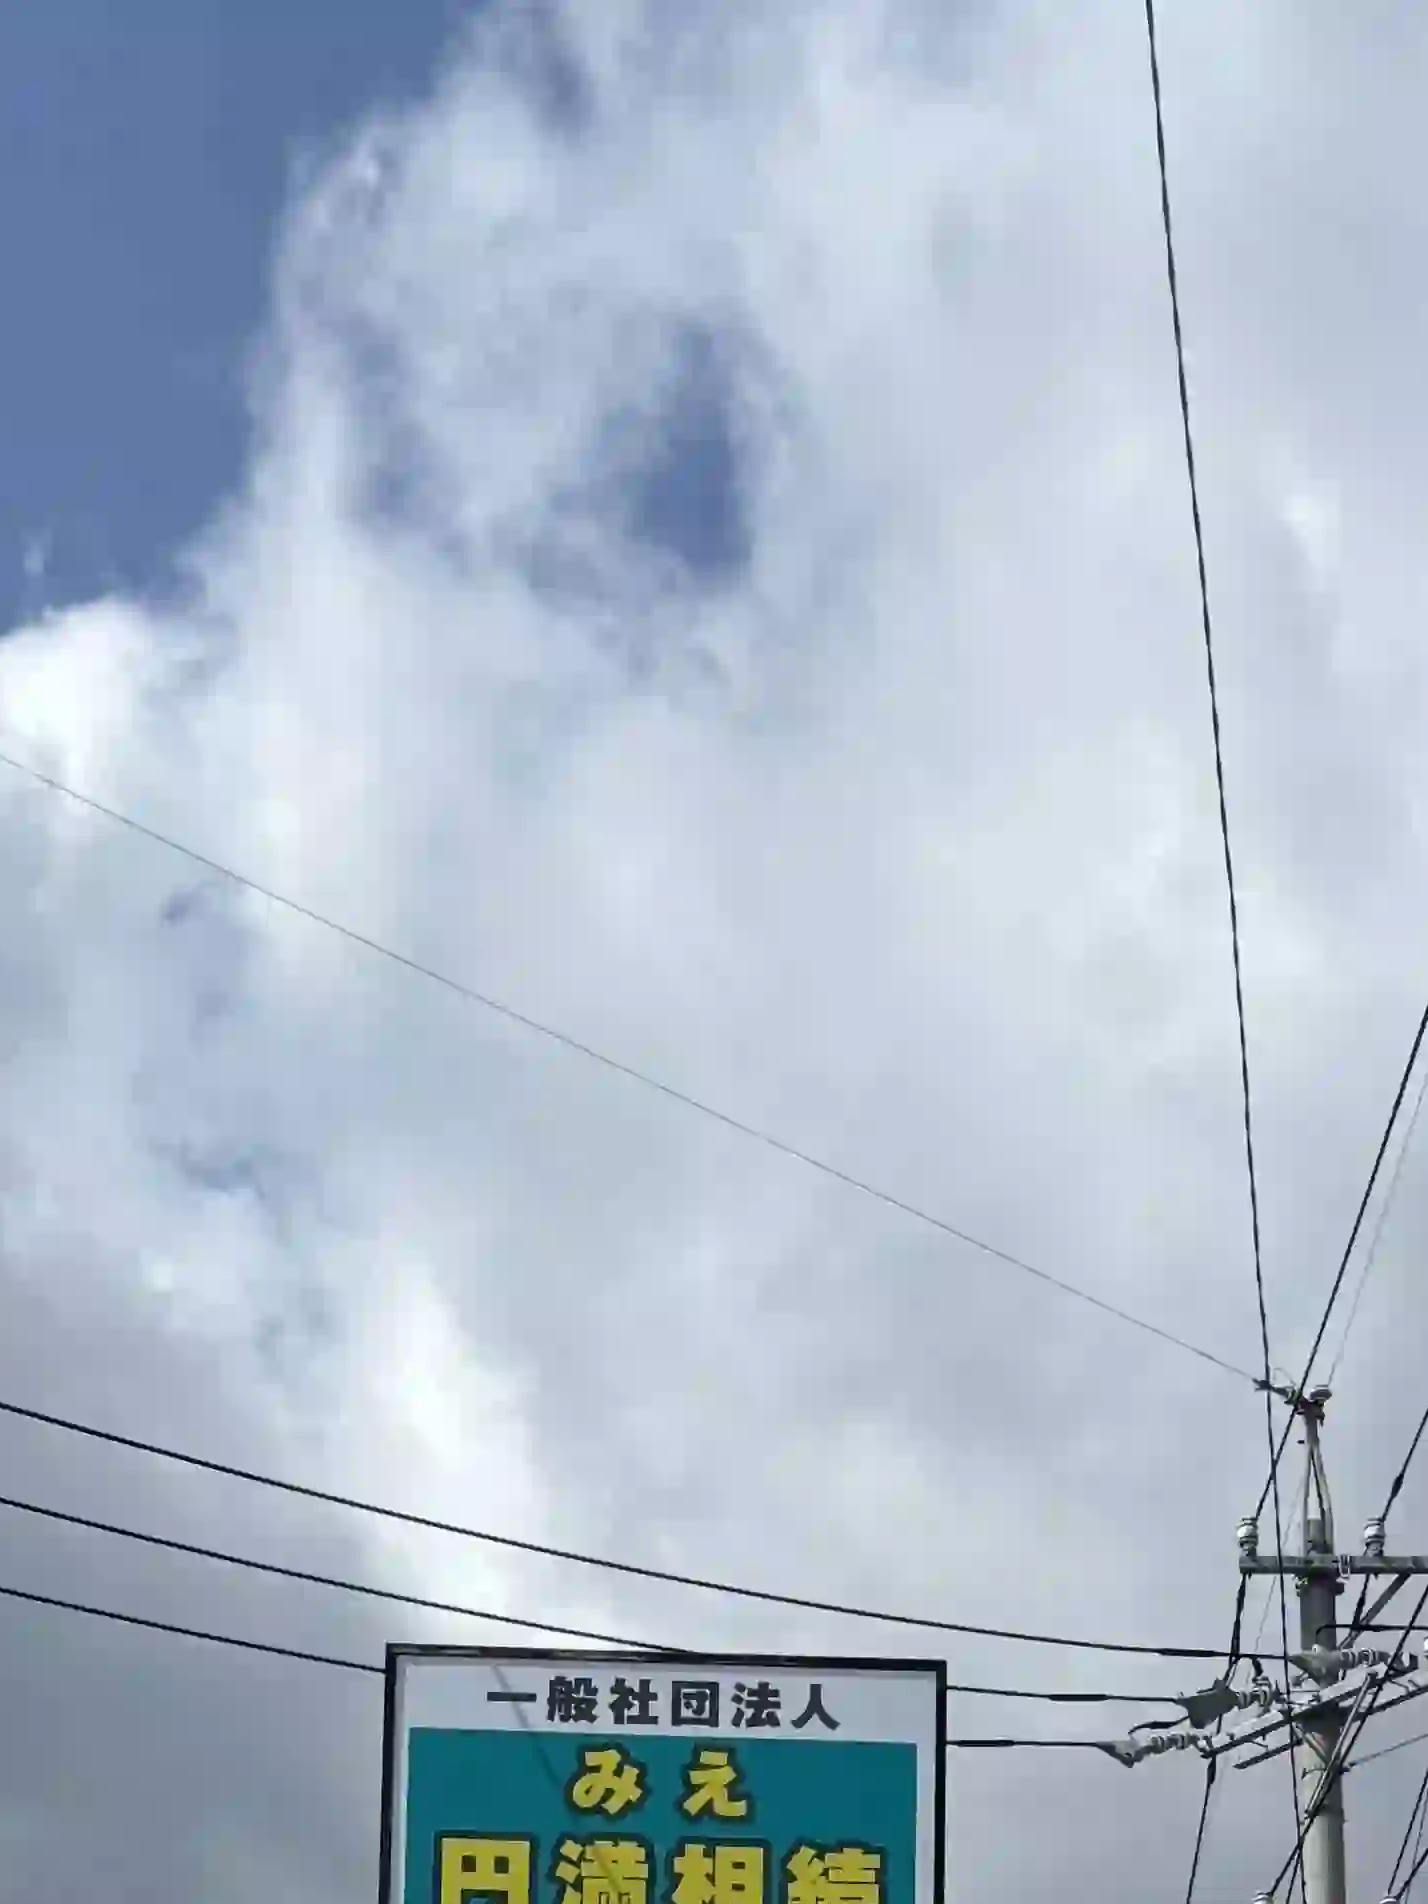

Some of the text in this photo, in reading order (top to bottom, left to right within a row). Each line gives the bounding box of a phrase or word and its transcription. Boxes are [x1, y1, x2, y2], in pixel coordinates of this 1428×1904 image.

[487, 1678, 840, 1730] 一般社団法人
[572, 1750, 747, 1817] みえ
